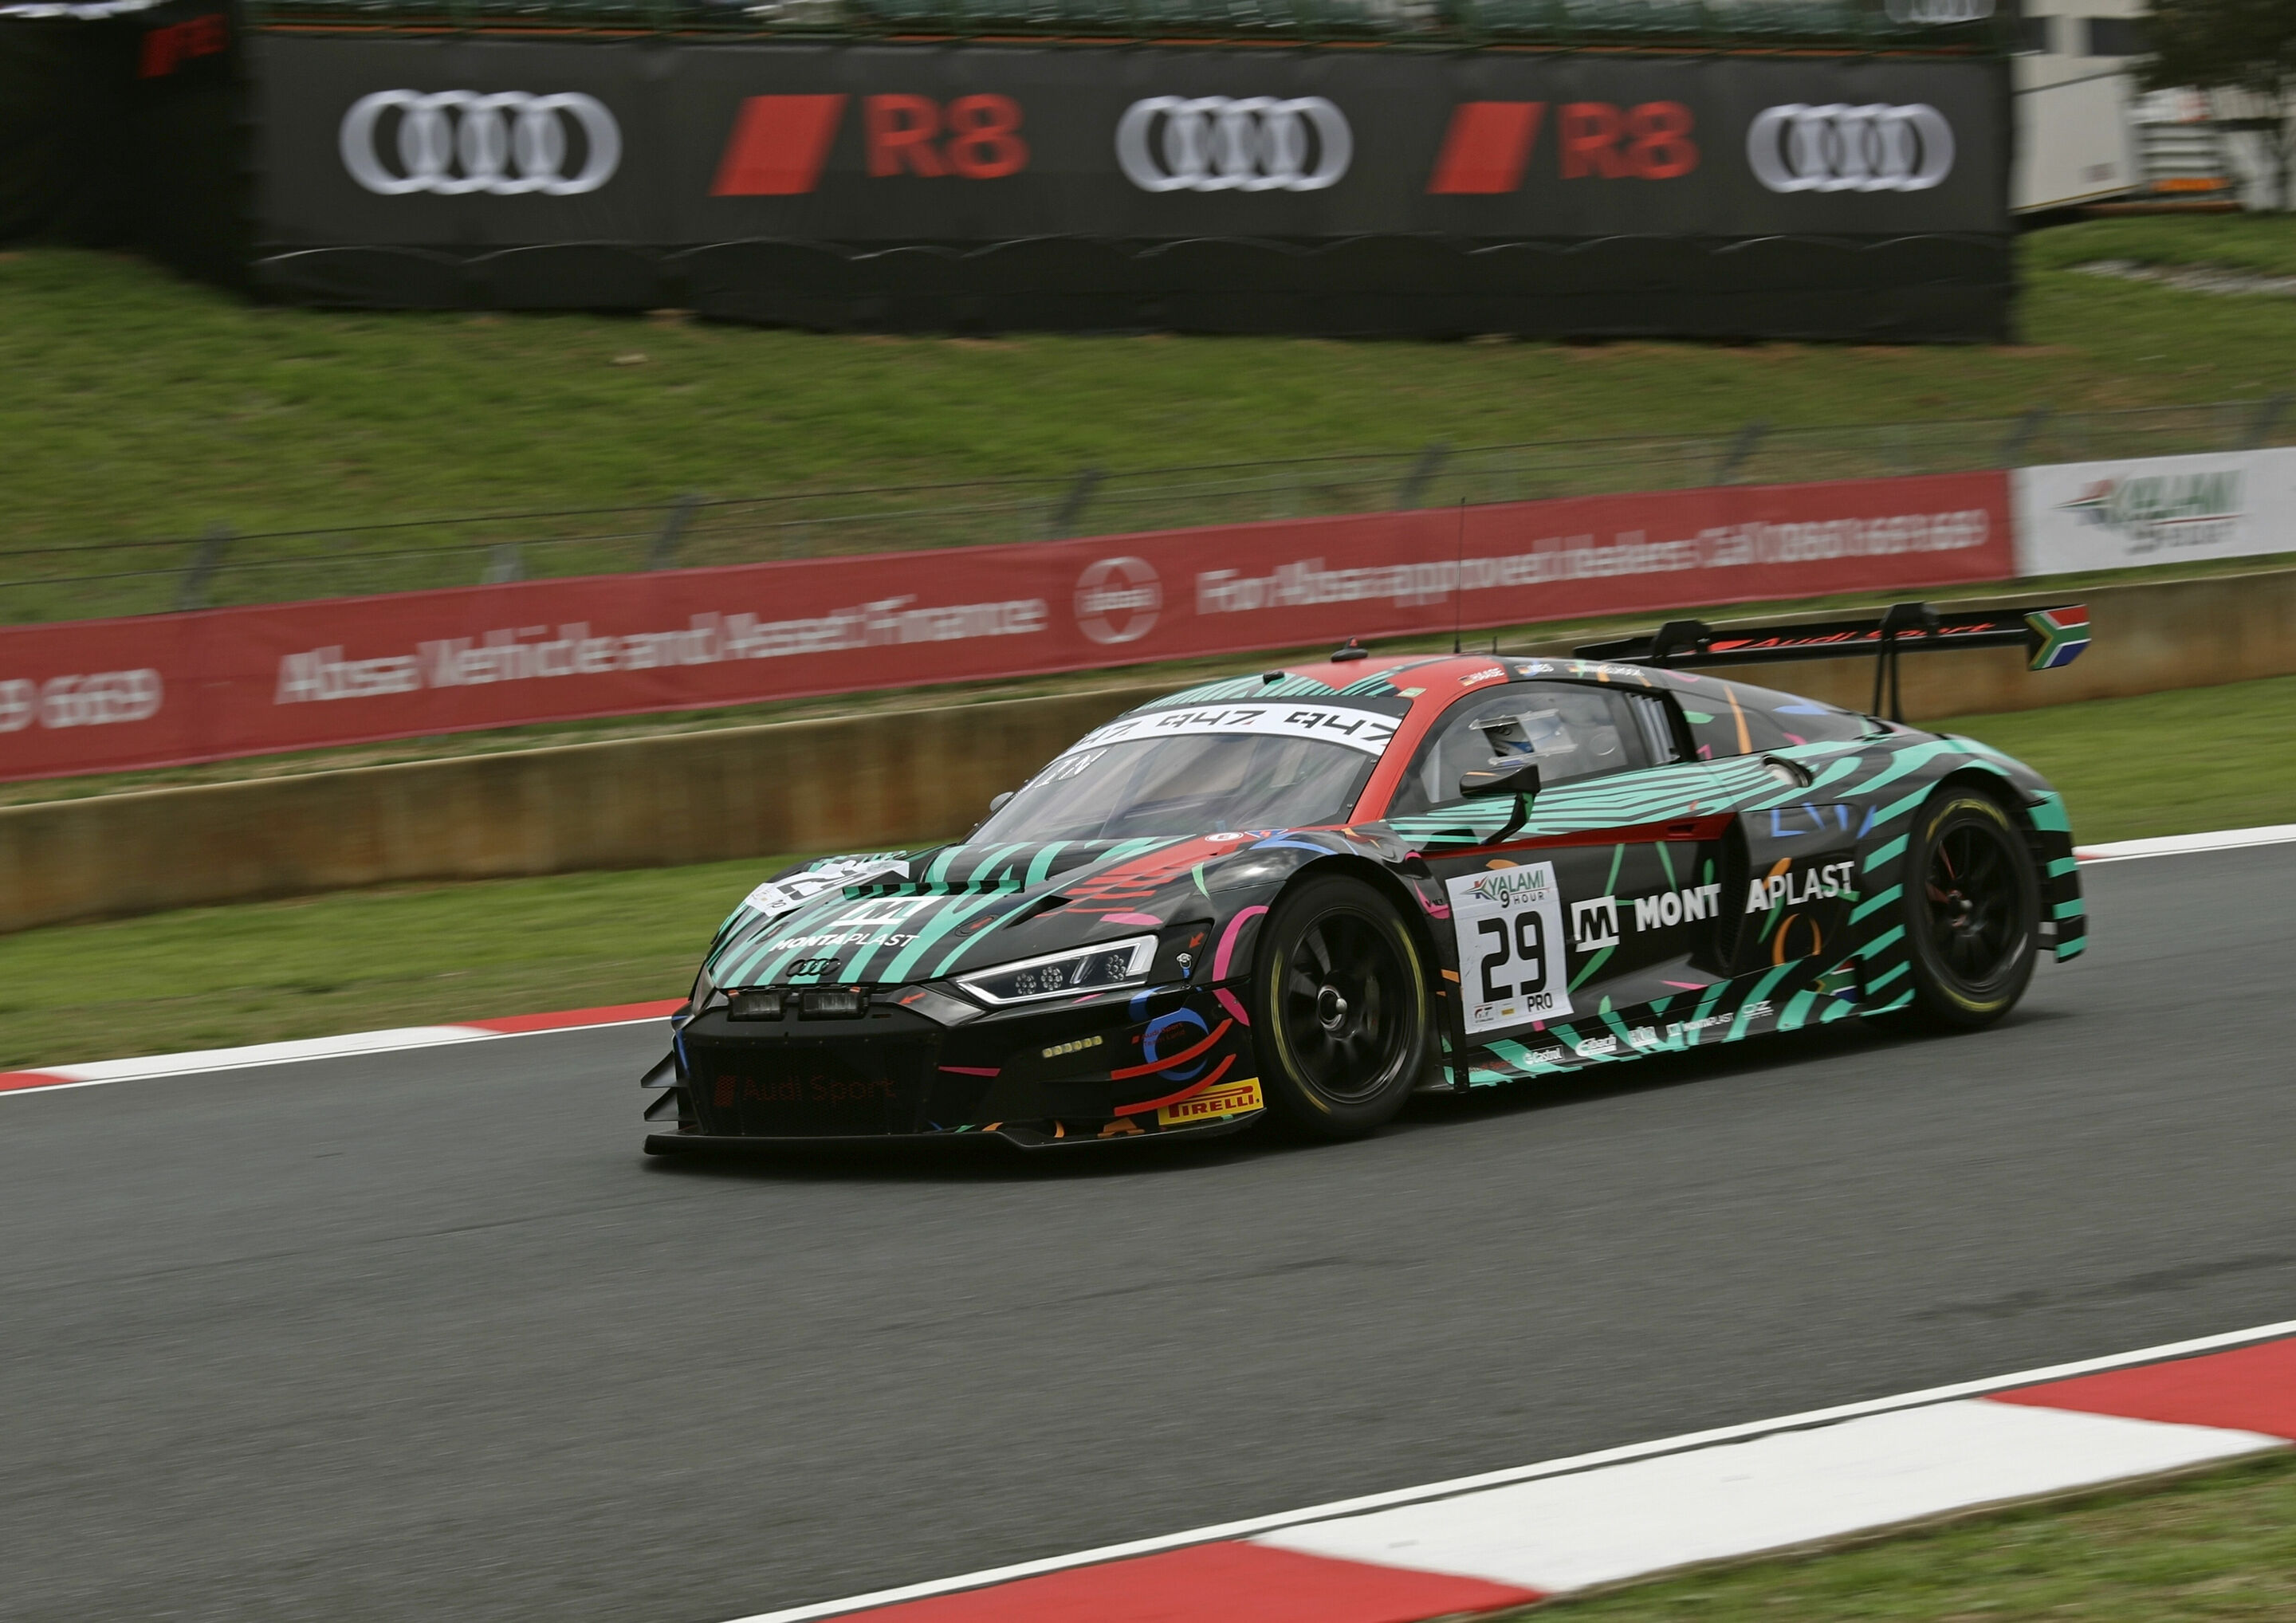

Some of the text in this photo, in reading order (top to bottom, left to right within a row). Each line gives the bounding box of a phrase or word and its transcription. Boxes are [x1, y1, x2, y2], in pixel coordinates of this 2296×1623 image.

[863, 92, 1030, 180] R8
[1557, 100, 1700, 180] R8
[277, 644, 421, 705] Absa
[618, 611, 721, 670] and
[1500, 890, 1545, 908] 9 HOUR
[1745, 861, 1855, 914] APLAST
[768, 933, 920, 952] MONTAPLAST
[1477, 910, 1547, 1003] 29
[1527, 992, 1553, 1012] PRO
[742, 1075, 896, 1104] Audi Sport
[1168, 1087, 1254, 1118] PIRELLI
